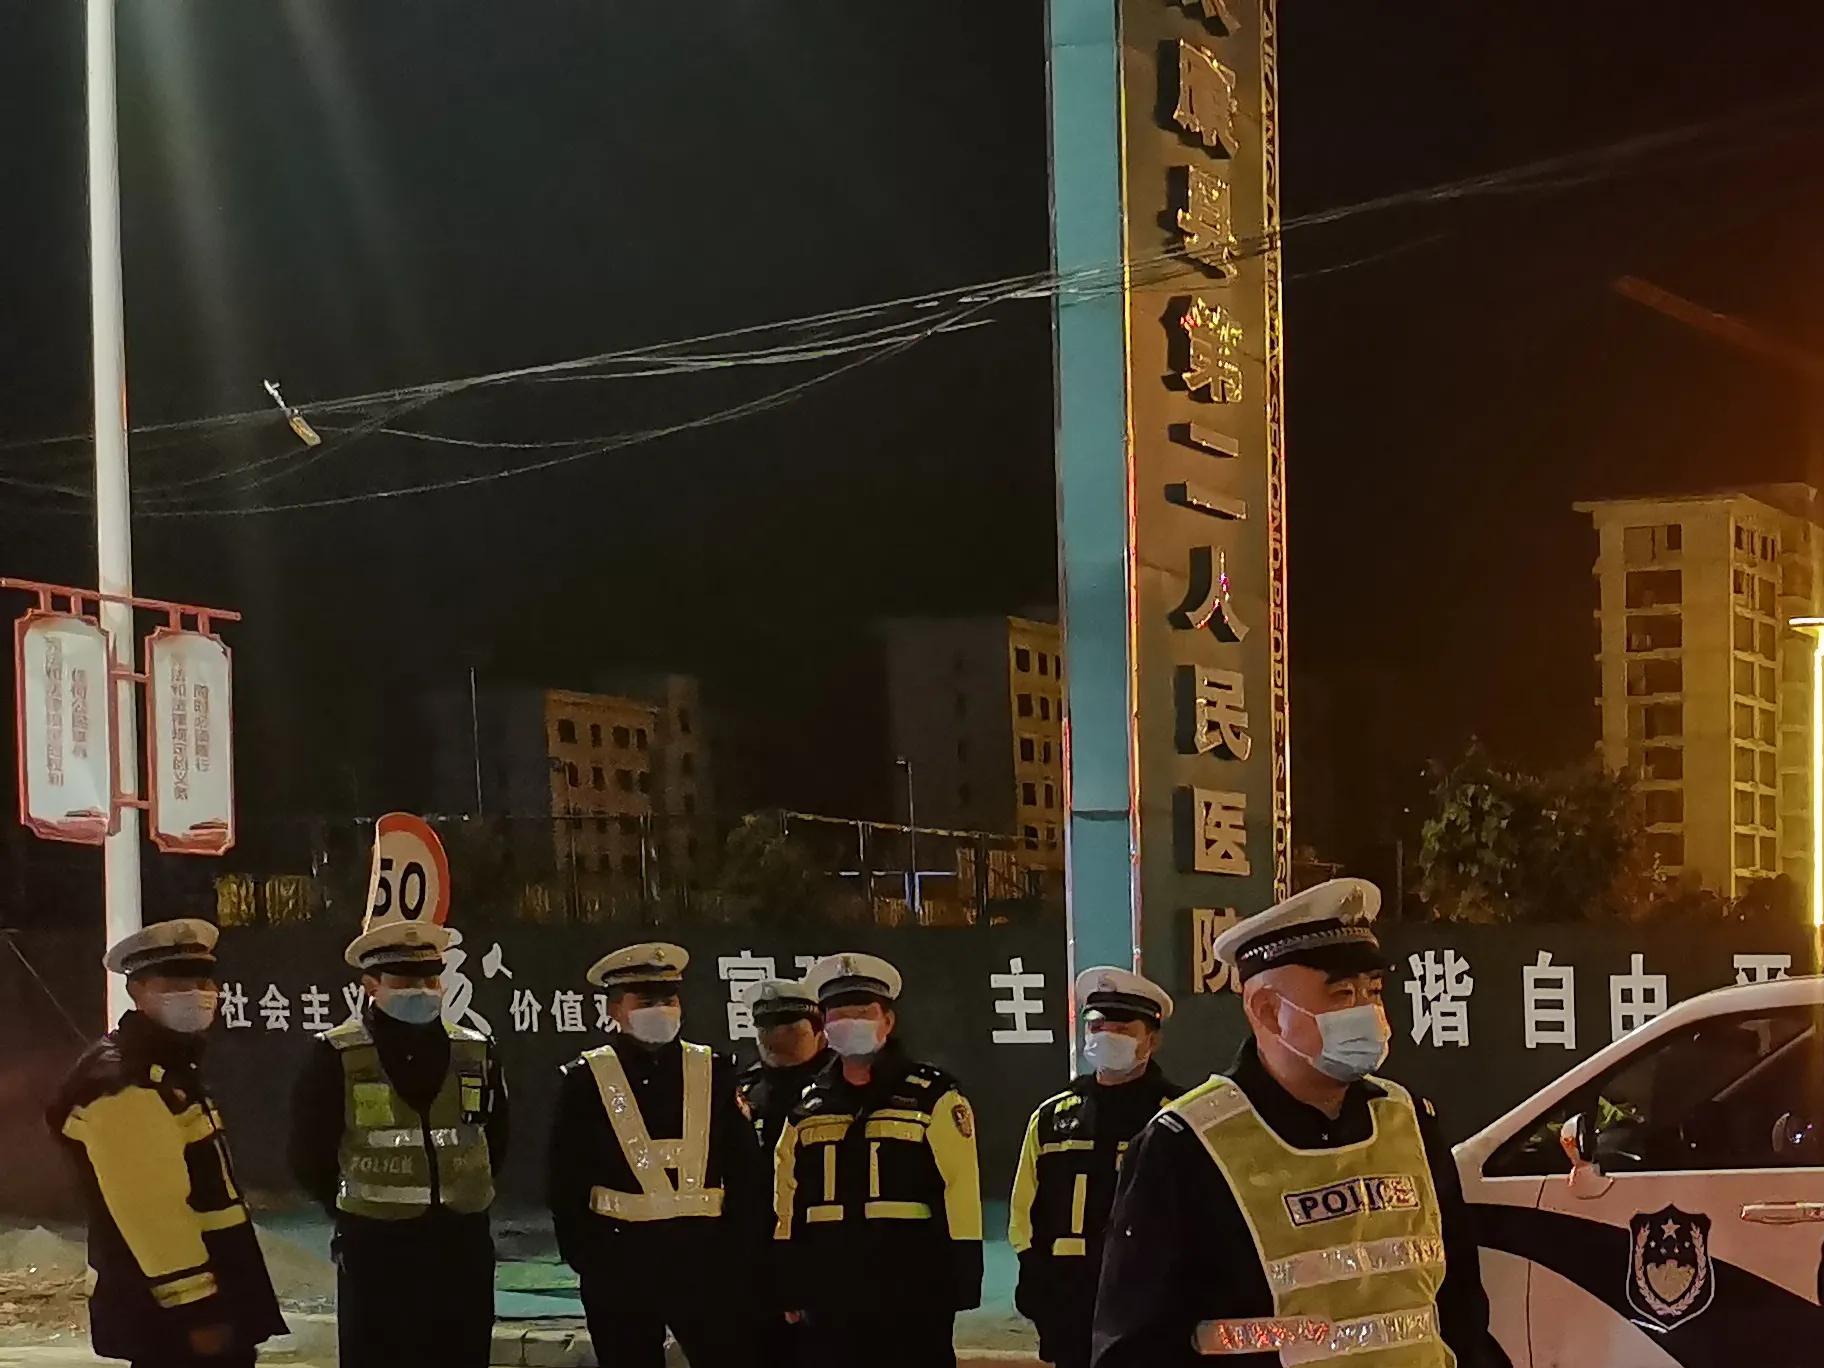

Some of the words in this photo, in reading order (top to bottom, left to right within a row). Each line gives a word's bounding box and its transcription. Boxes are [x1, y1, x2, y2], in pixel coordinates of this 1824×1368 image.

[1173, 0, 1250, 993] 康县第二人民医院
[1270, 396, 1282, 569] SECOND
[1271, 580, 1285, 779] PEOPLE'S
[371, 857, 427, 920] 50
